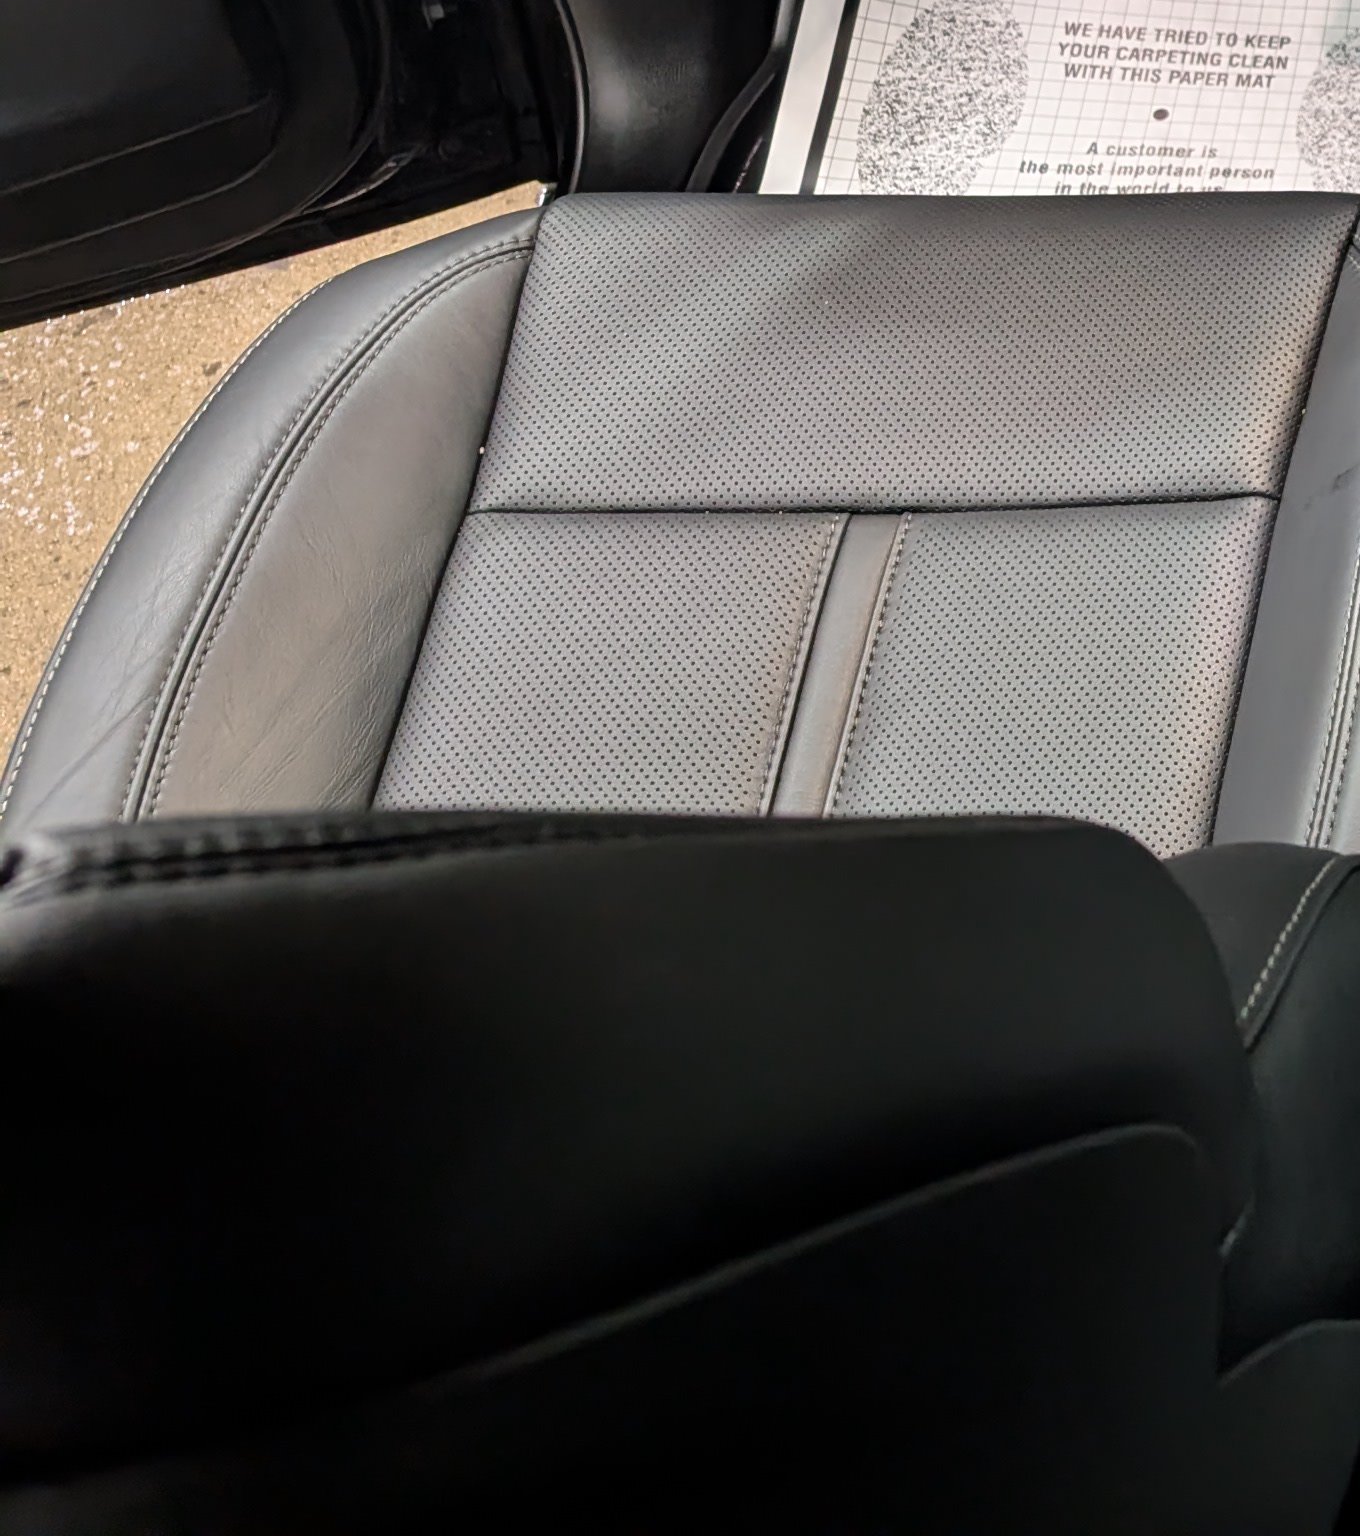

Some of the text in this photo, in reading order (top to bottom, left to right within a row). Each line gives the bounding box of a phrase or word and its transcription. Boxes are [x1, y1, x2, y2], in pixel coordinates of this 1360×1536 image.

[1064, 21, 1291, 50] WE HAVE TRIED TO KEEP
[1058, 42, 1289, 70] YOUR CARPETING CLEAN
[1064, 63, 1276, 89] WITH THIS PAPER MAT
[1086, 142, 1217, 158] A customer is
[1019, 160, 1275, 182] the most important person
[1055, 182, 1071, 194] in
[1079, 182, 1109, 194] the
[1116, 181, 1169, 193] world
[1177, 181, 1194, 192] to
